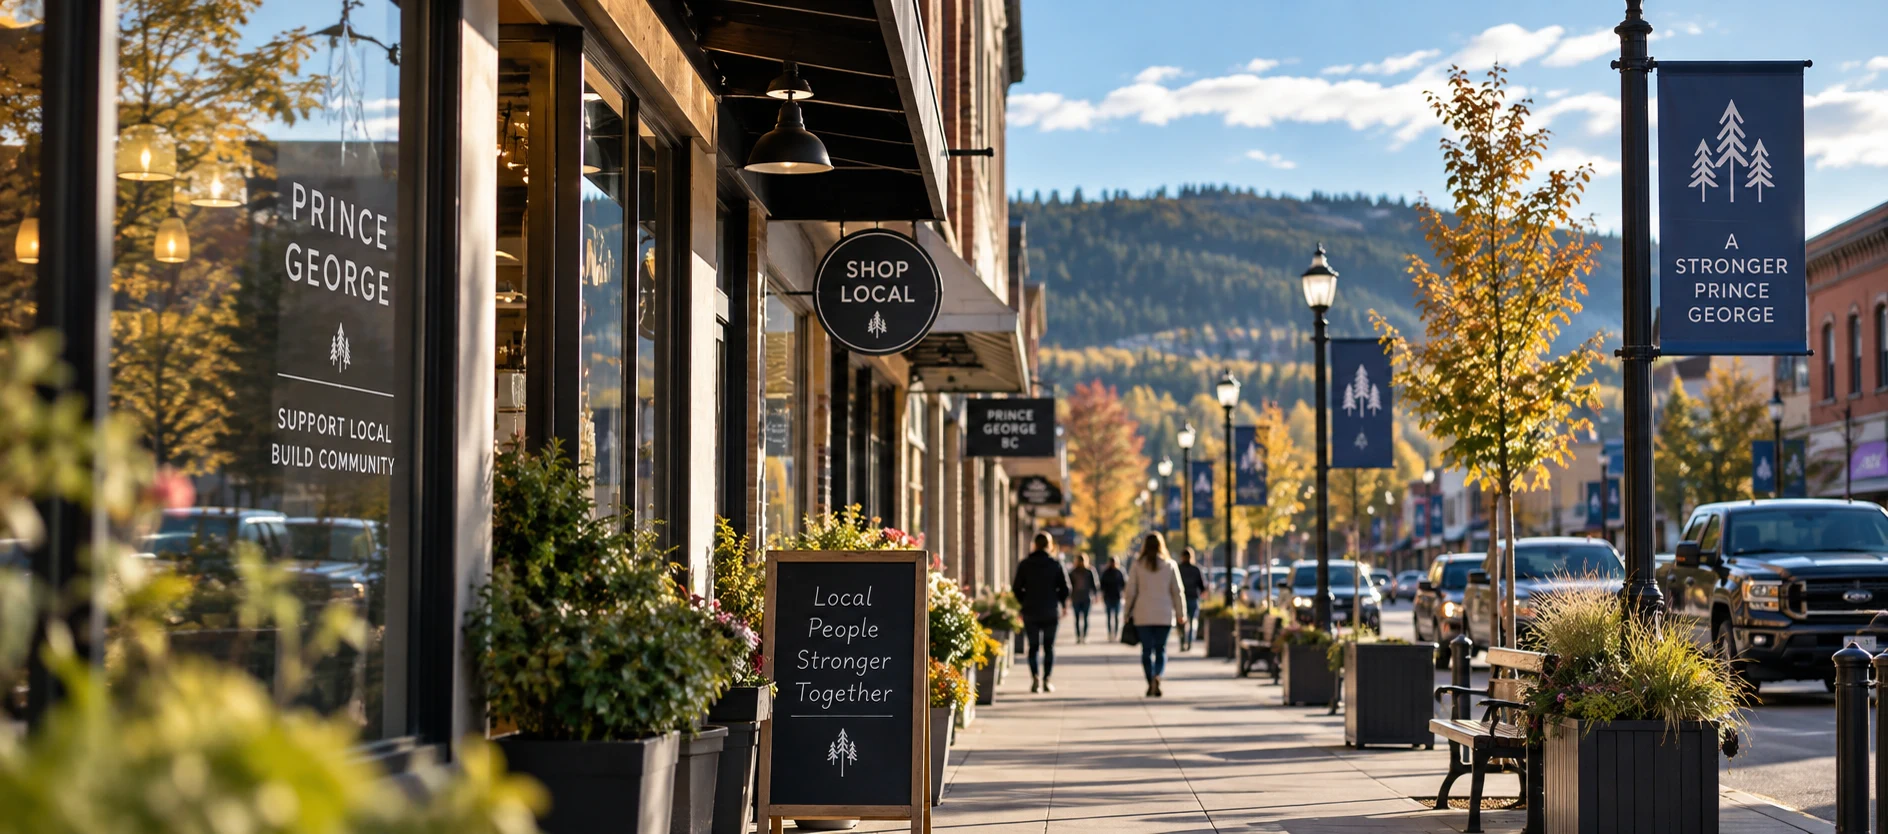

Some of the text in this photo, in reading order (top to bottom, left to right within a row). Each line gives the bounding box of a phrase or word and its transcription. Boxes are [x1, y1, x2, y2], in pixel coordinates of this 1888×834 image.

[292, 182, 388, 251] PRINCE
[1725, 233, 1739, 249] A
[285, 242, 390, 306] GEORGE
[846, 260, 909, 278] SHOP
[1675, 258, 1788, 274] STRONGER
[841, 285, 915, 303] LOCAL
[1695, 282, 1769, 298] PRINCE
[1688, 306, 1774, 322] GEORGE
[987, 409, 1033, 421] PRINCE
[277, 407, 392, 443] SUPPORT LOCAL
[983, 422, 1036, 435] GEORGE
[1001, 436, 1019, 449] BC
[271, 443, 395, 475] BUILD COMMUNITY
[814, 585, 872, 607] Local
[808, 617, 879, 645] People
[797, 649, 892, 676] Stronger
[795, 681, 892, 710] Together
